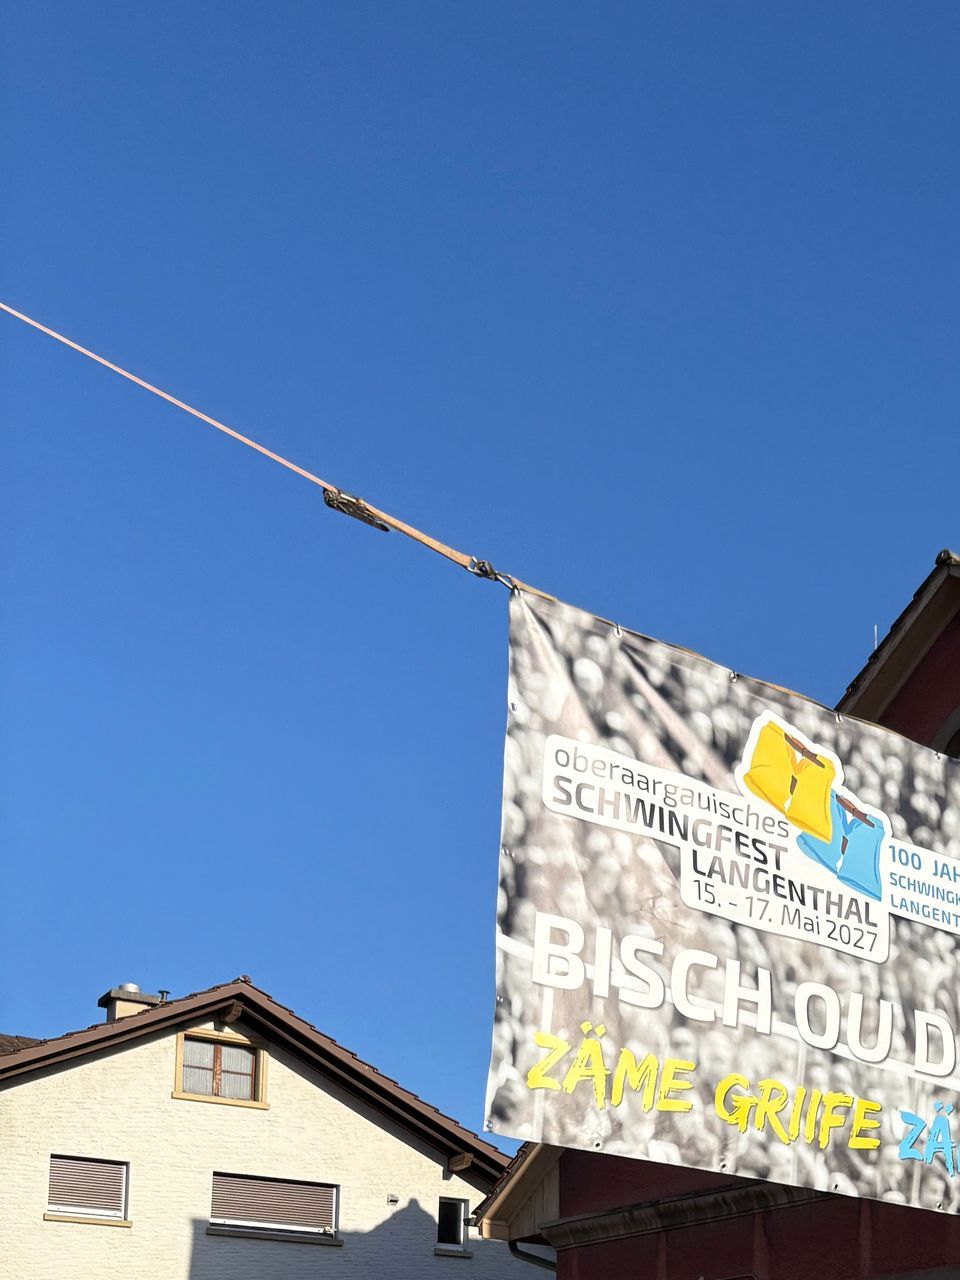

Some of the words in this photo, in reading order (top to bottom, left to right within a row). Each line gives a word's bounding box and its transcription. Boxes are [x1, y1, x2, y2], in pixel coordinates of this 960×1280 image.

[552, 775, 789, 872] SCHWINGFEST
[555, 747, 790, 838] oberaargauisches
[692, 850, 879, 928] LANGENTHAL
[888, 845, 922, 871] 100
[693, 879, 722, 908] 15.
[745, 896, 773, 923] 17.
[780, 905, 821, 936] Mai
[825, 920, 878, 952] 2027
[531, 911, 772, 1035] BISCH
[794, 981, 893, 1063] OU
[526, 1021, 697, 1113] ZÄME
[714, 1073, 883, 1150] GRIIFE
